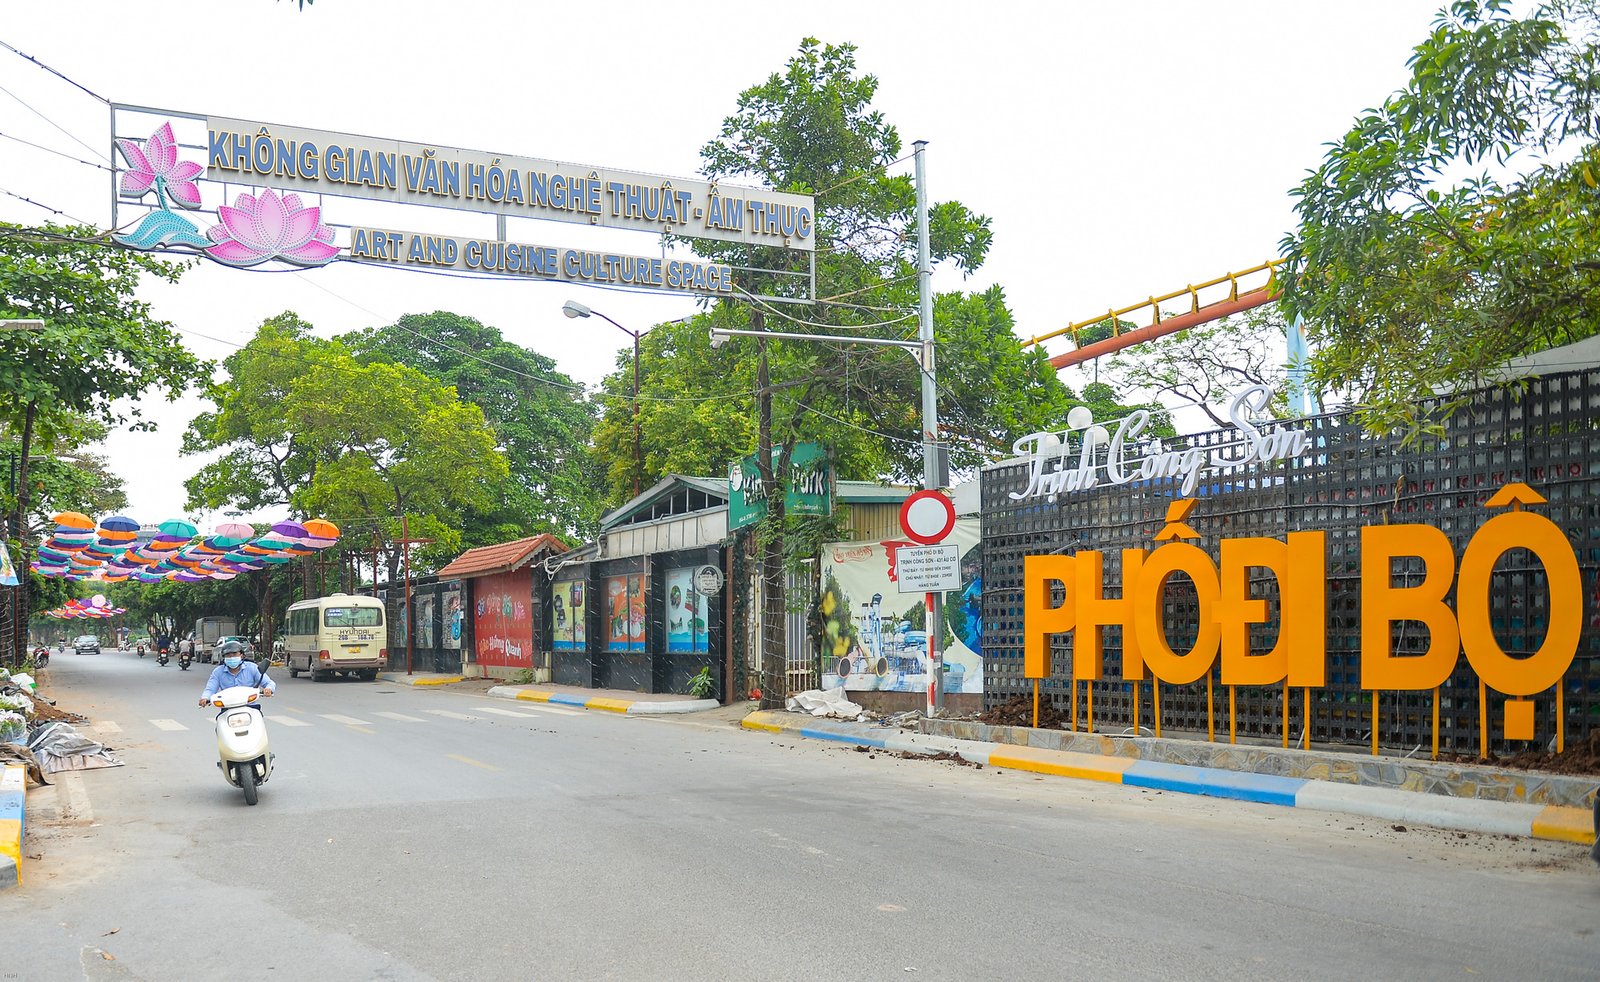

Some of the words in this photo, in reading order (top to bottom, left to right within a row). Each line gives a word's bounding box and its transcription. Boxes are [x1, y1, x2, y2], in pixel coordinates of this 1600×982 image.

[207, 126, 319, 179] KHÔNG
[324, 144, 398, 190] GIAN
[404, 148, 461, 197] VĂN
[467, 157, 525, 205] HÓA
[528, 171, 602, 225] NGHỆ
[607, 179, 692, 233] THUẬT
[705, 181, 744, 231] ẨM
[747, 199, 812, 247] THỰC
[352, 227, 404, 261] ART
[407, 234, 459, 266] AND
[464, 240, 559, 276] CUISINE
[562, 249, 663, 287] CULTURE
[667, 259, 733, 293] SPACE
[1008, 428, 1099, 504] Trịnh
[1107, 408, 1205, 497] Công
[1210, 384, 1308, 468] Sơn
[1024, 498, 1221, 686] PHỐ
[1211, 530, 1328, 687] ĐI
[1361, 483, 1584, 741] BỘ
